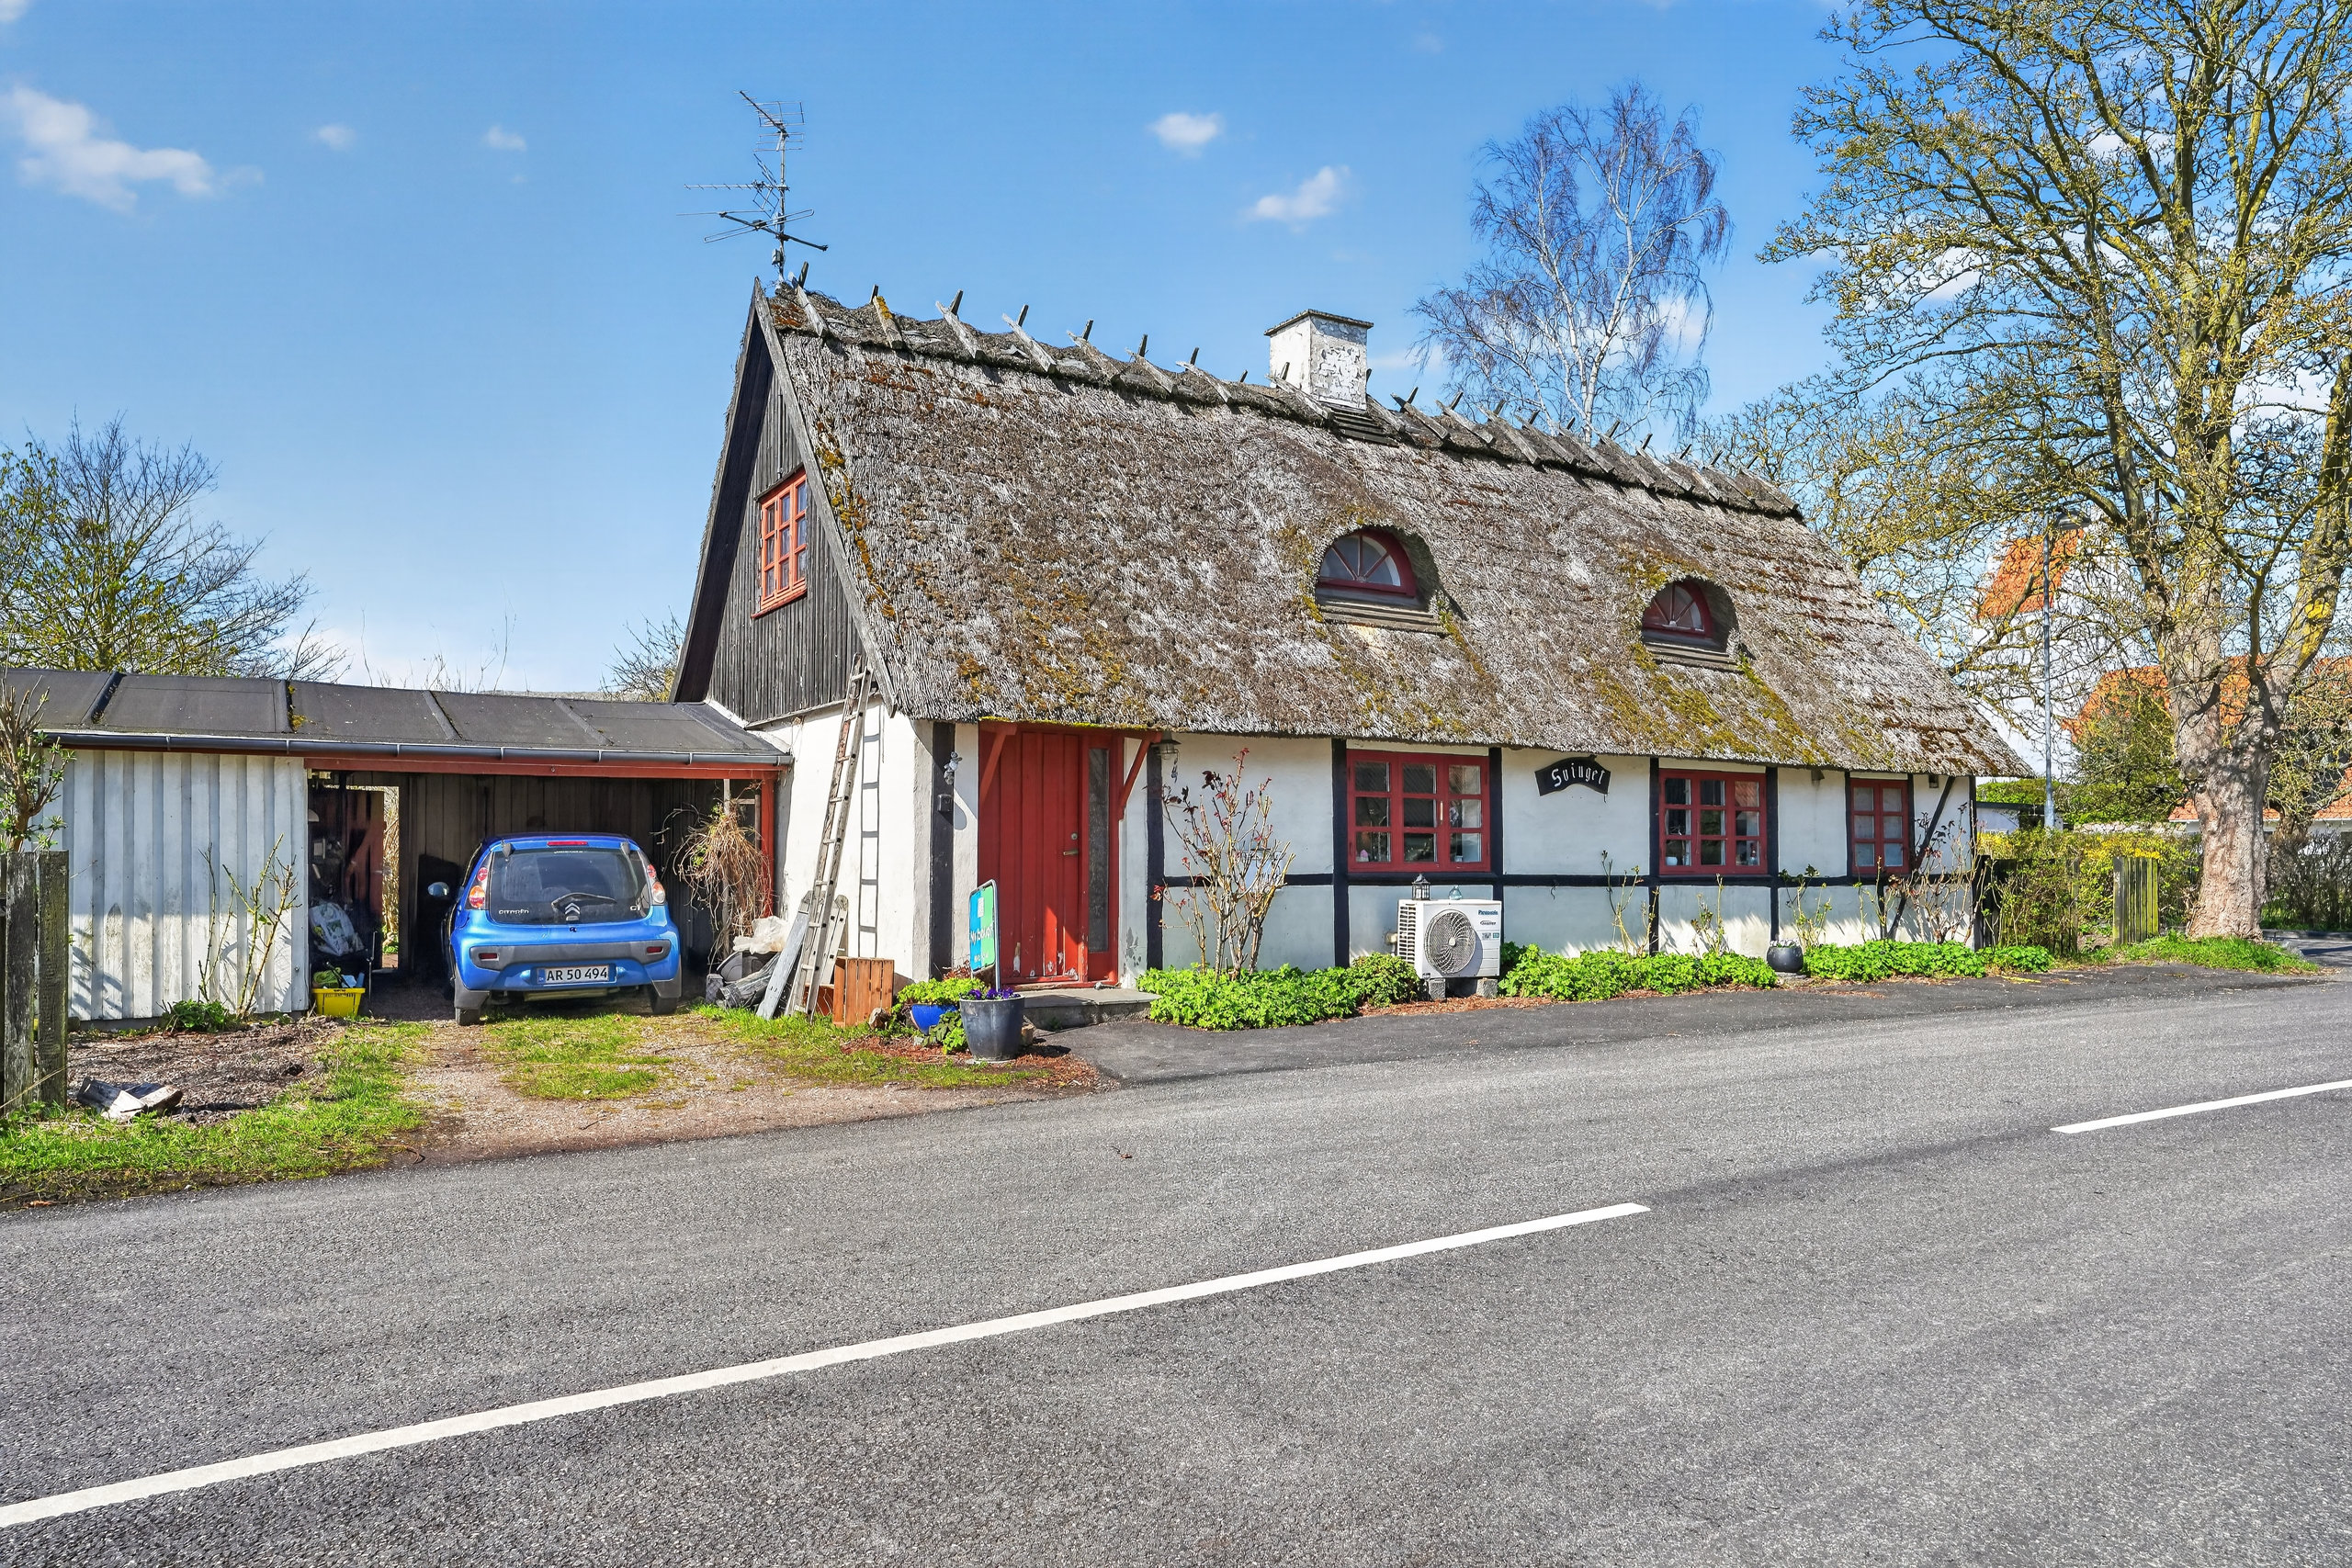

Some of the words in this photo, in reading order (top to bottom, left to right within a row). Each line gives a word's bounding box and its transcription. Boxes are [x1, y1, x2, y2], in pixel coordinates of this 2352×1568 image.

[547, 970, 563, 981] AR
[567, 968, 582, 980] 50
[584, 967, 607, 979] 494
